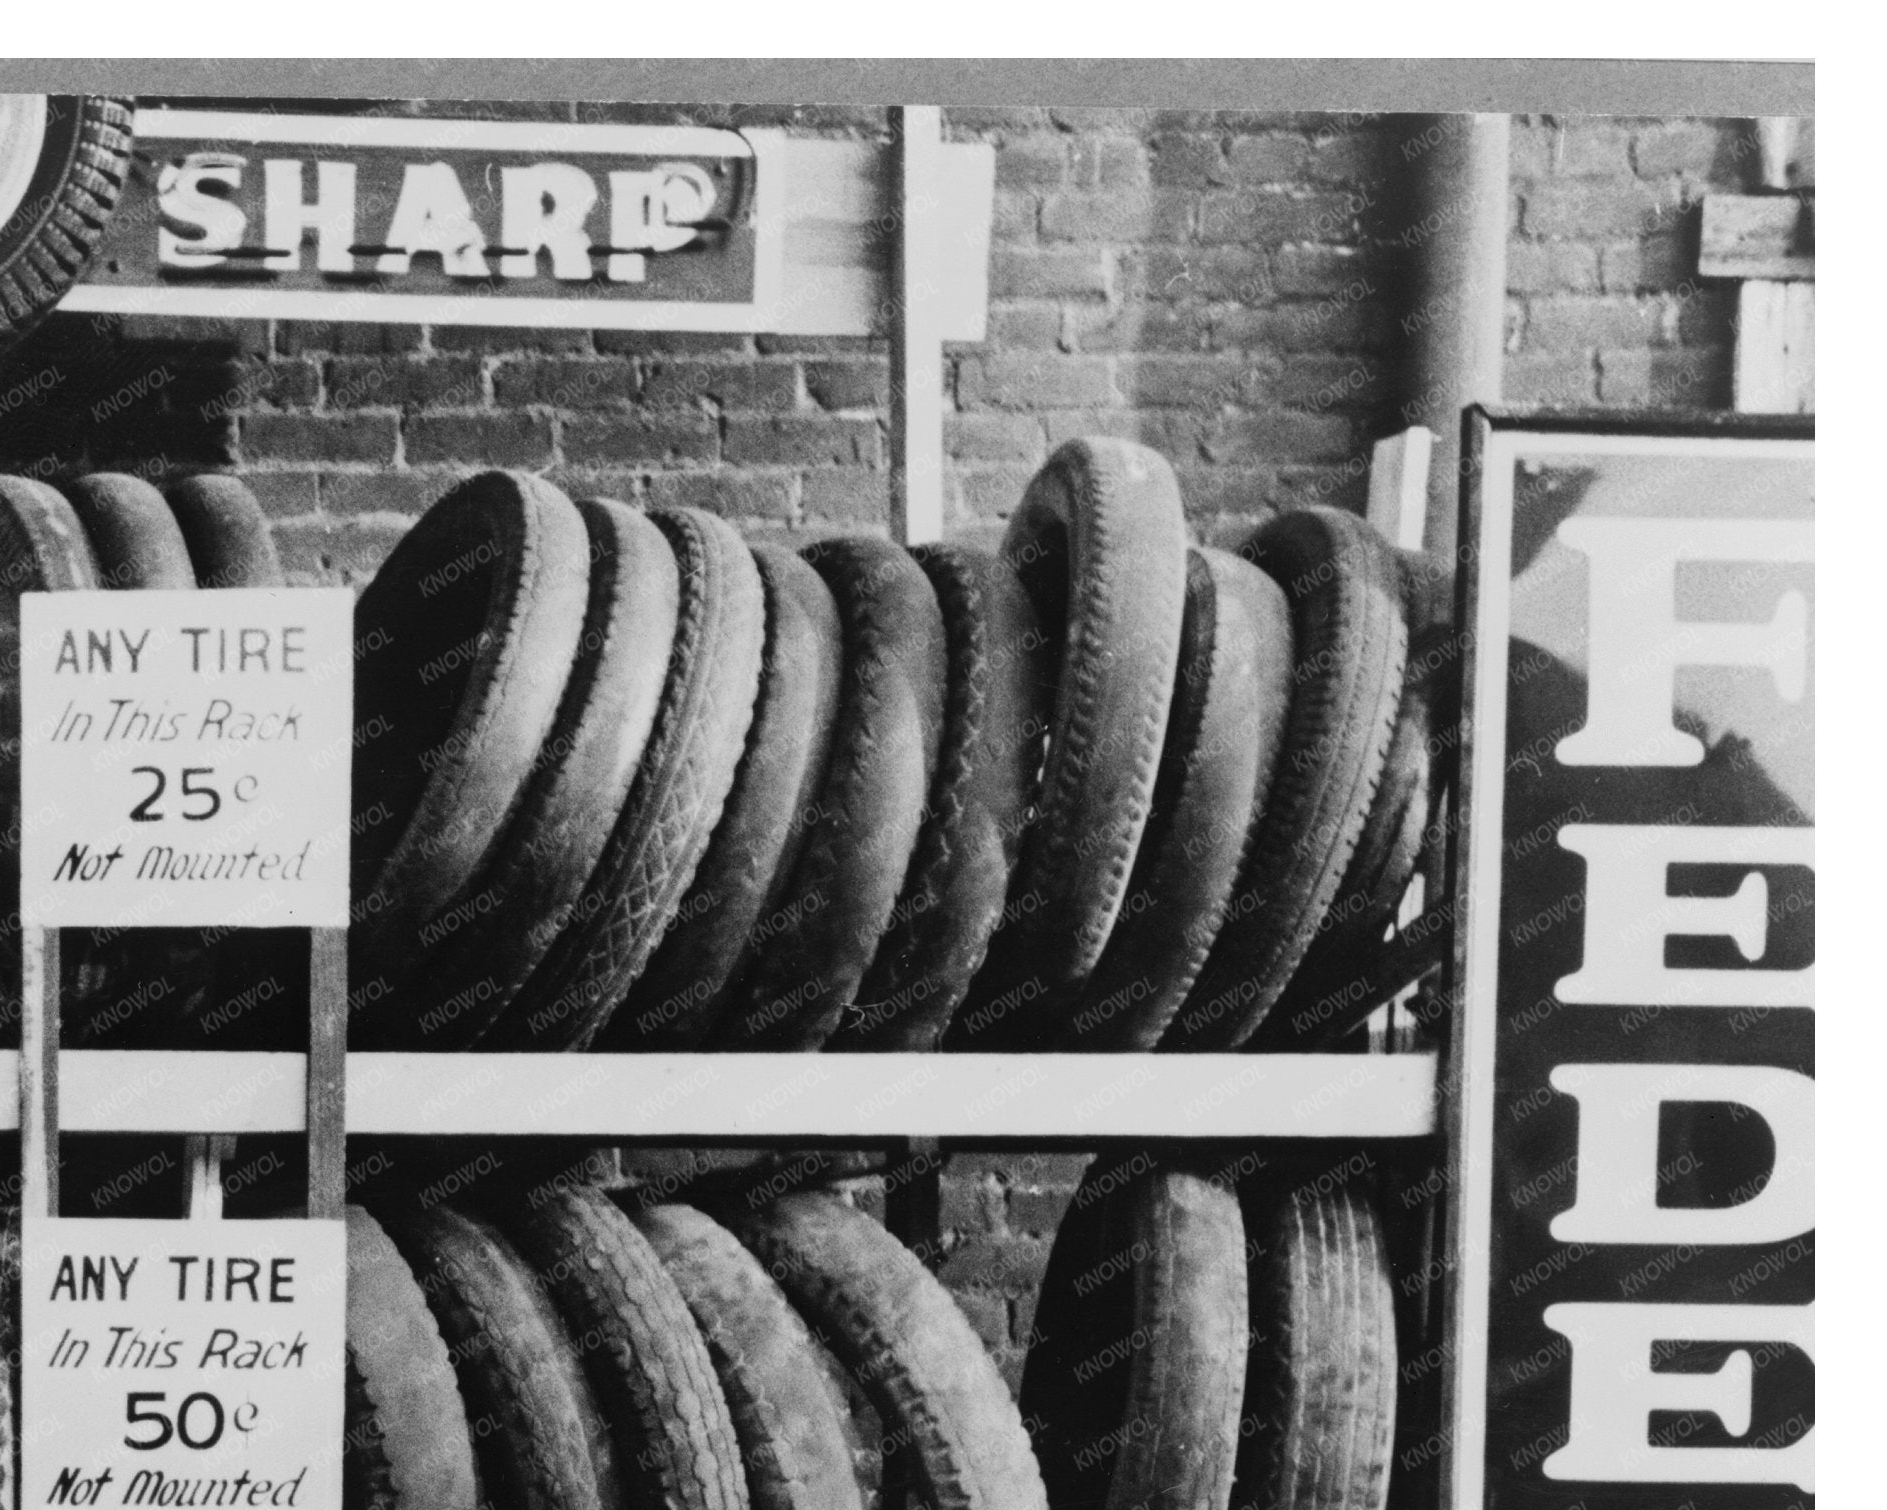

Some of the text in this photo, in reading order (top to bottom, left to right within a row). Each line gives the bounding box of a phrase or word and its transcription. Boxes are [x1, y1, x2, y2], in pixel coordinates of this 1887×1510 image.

[157, 152, 716, 283] SHARP
[54, 626, 306, 675] ANY TIRE
[51, 699, 304, 743] In This Rack
[52, 840, 312, 883] Not Mounted
[49, 1254, 296, 1303] ANY TIRE
[47, 1326, 310, 1370] In This Rack
[46, 1466, 308, 1507] Not Mounted
